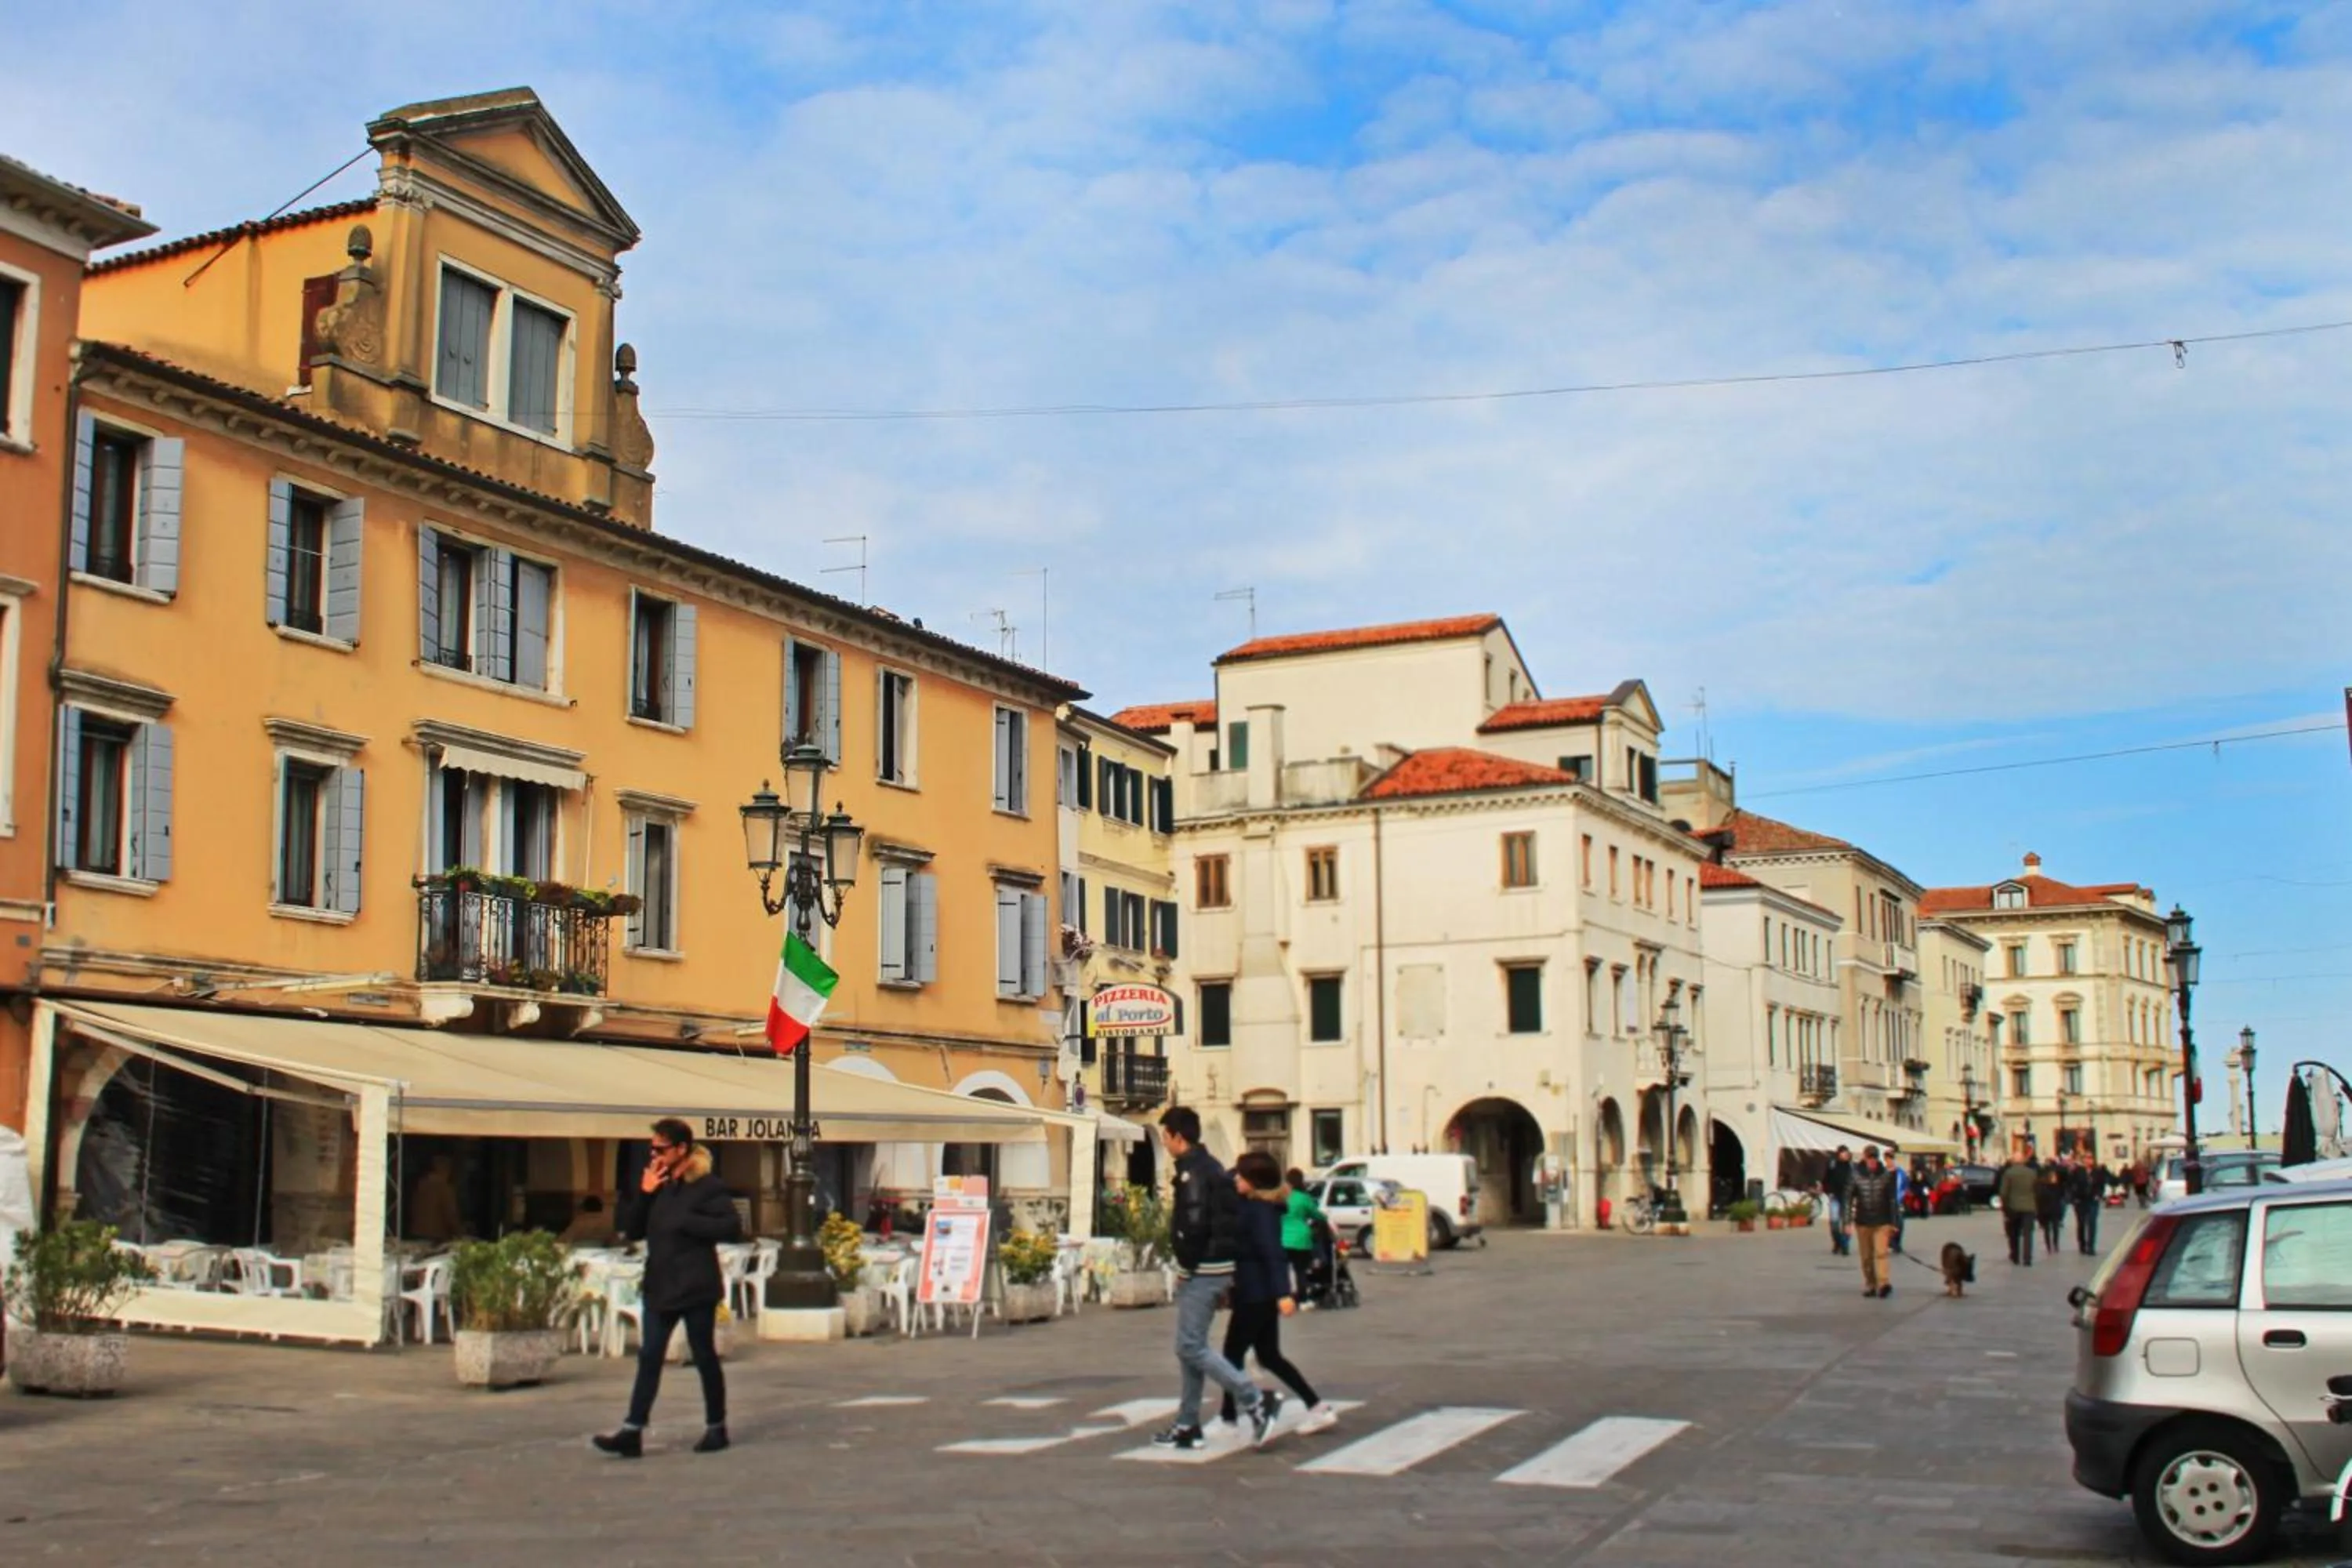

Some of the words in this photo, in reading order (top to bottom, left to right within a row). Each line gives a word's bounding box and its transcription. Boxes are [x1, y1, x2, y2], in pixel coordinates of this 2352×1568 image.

[1094, 989, 1167, 1007] PIZZERIA
[1118, 1007, 1163, 1022] Porto
[1094, 1027, 1168, 1038] RISTORANTE
[706, 1118, 738, 1138] BAR
[746, 1119, 822, 1138] JOLANA
